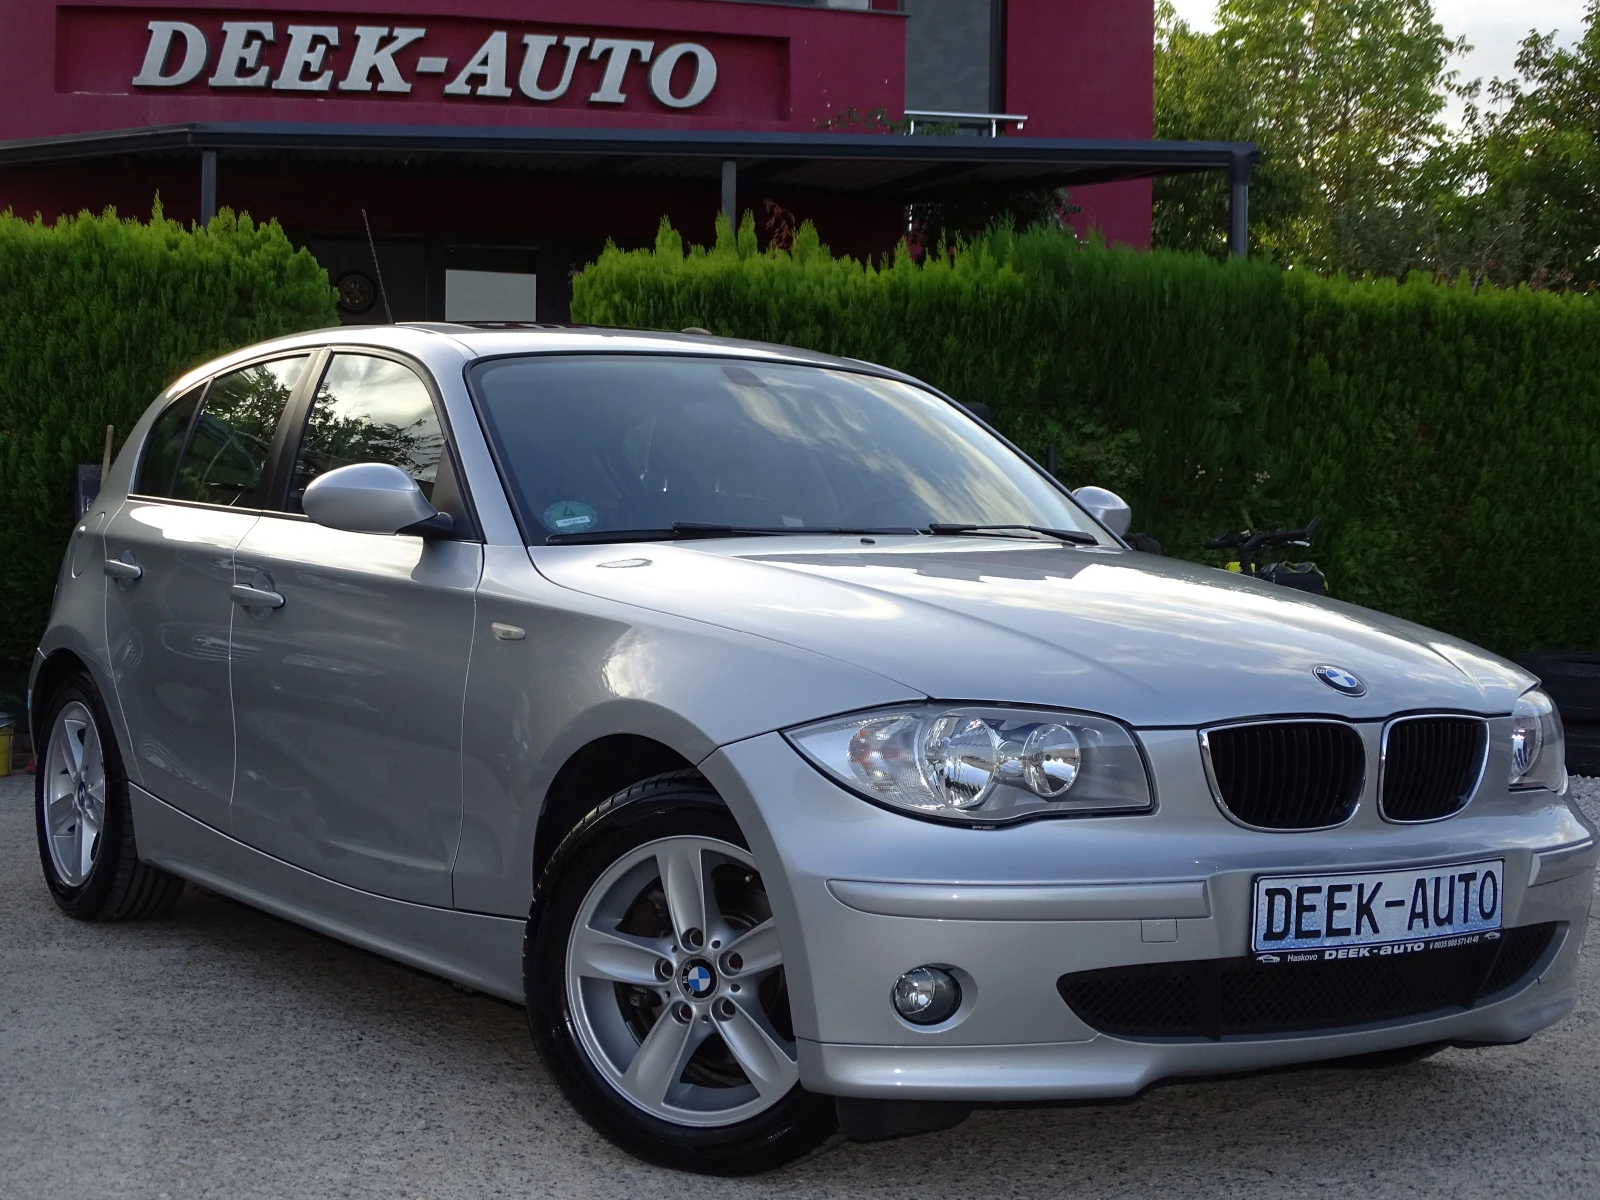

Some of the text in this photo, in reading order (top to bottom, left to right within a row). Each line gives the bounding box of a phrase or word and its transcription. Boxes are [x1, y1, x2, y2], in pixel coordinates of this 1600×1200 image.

[131, 20, 718, 109] DEEK-AUTO
[1263, 870, 1498, 941] DEEK-AUTO
[682, 962, 695, 996] BMW
[1287, 954, 1318, 962] Haskovo
